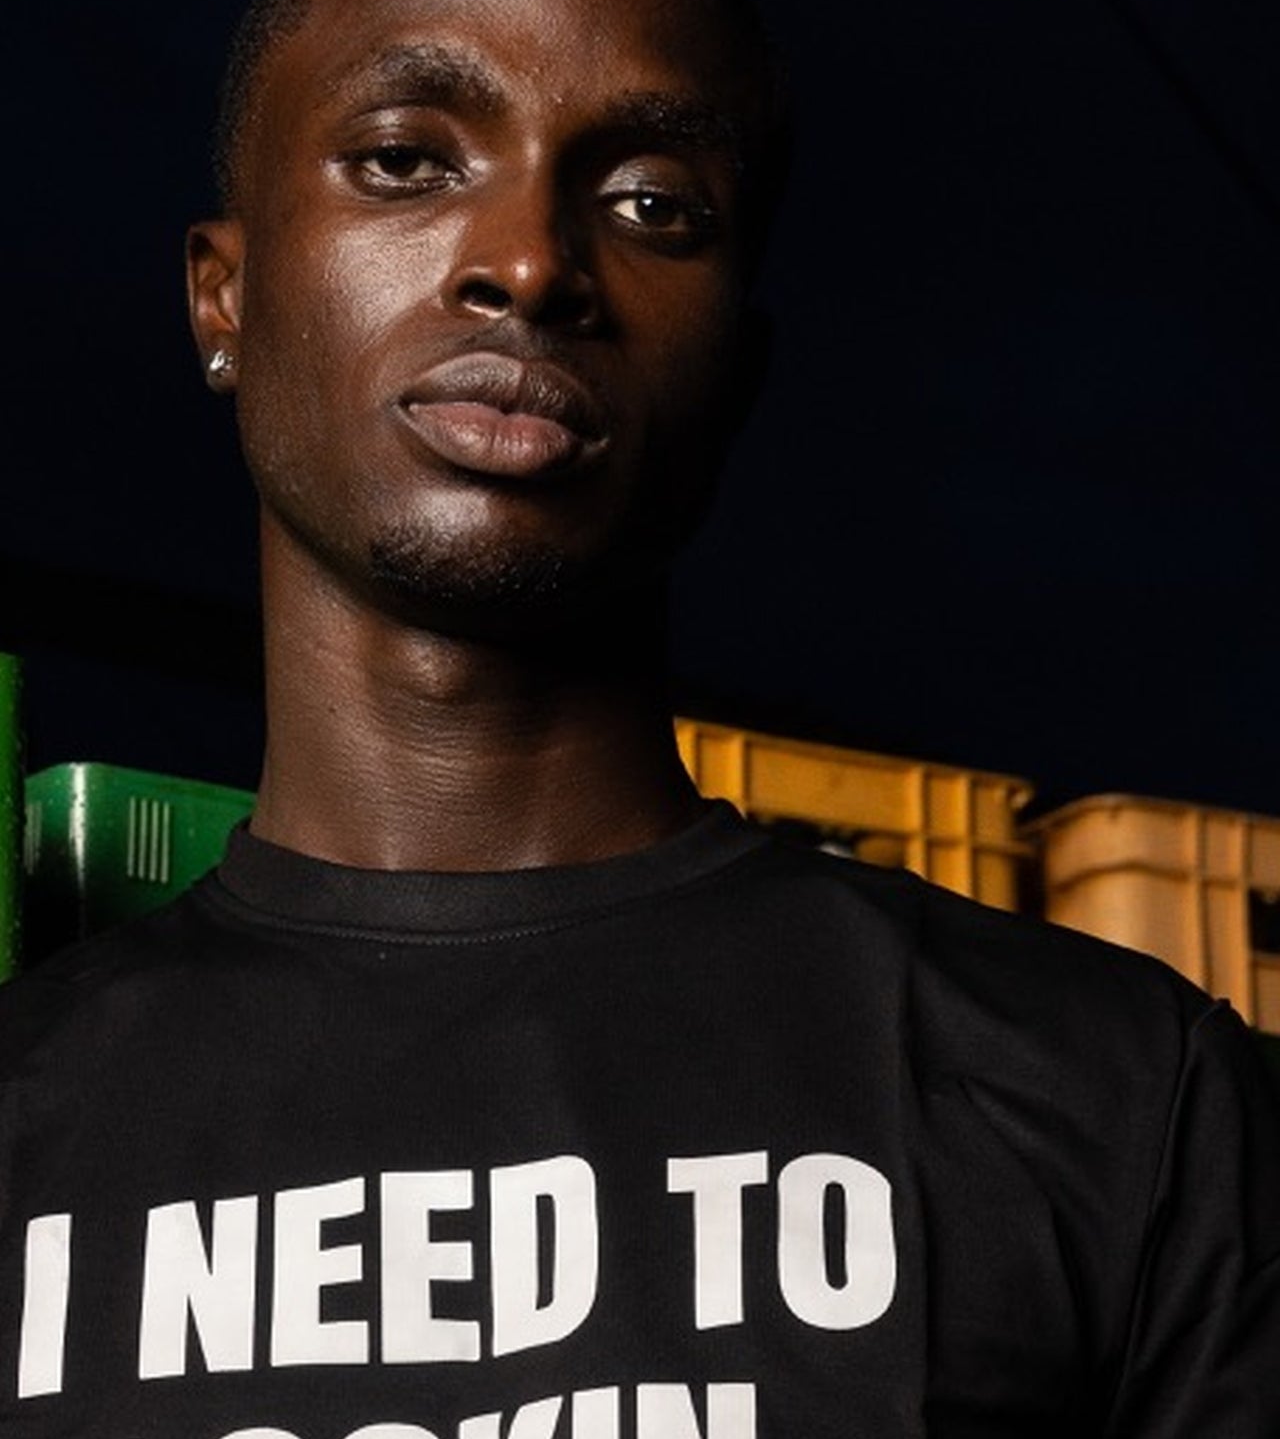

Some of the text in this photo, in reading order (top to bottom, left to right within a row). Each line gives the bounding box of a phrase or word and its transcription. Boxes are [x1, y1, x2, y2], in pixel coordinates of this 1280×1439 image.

[17, 1150, 897, 1399] I NEED TO
